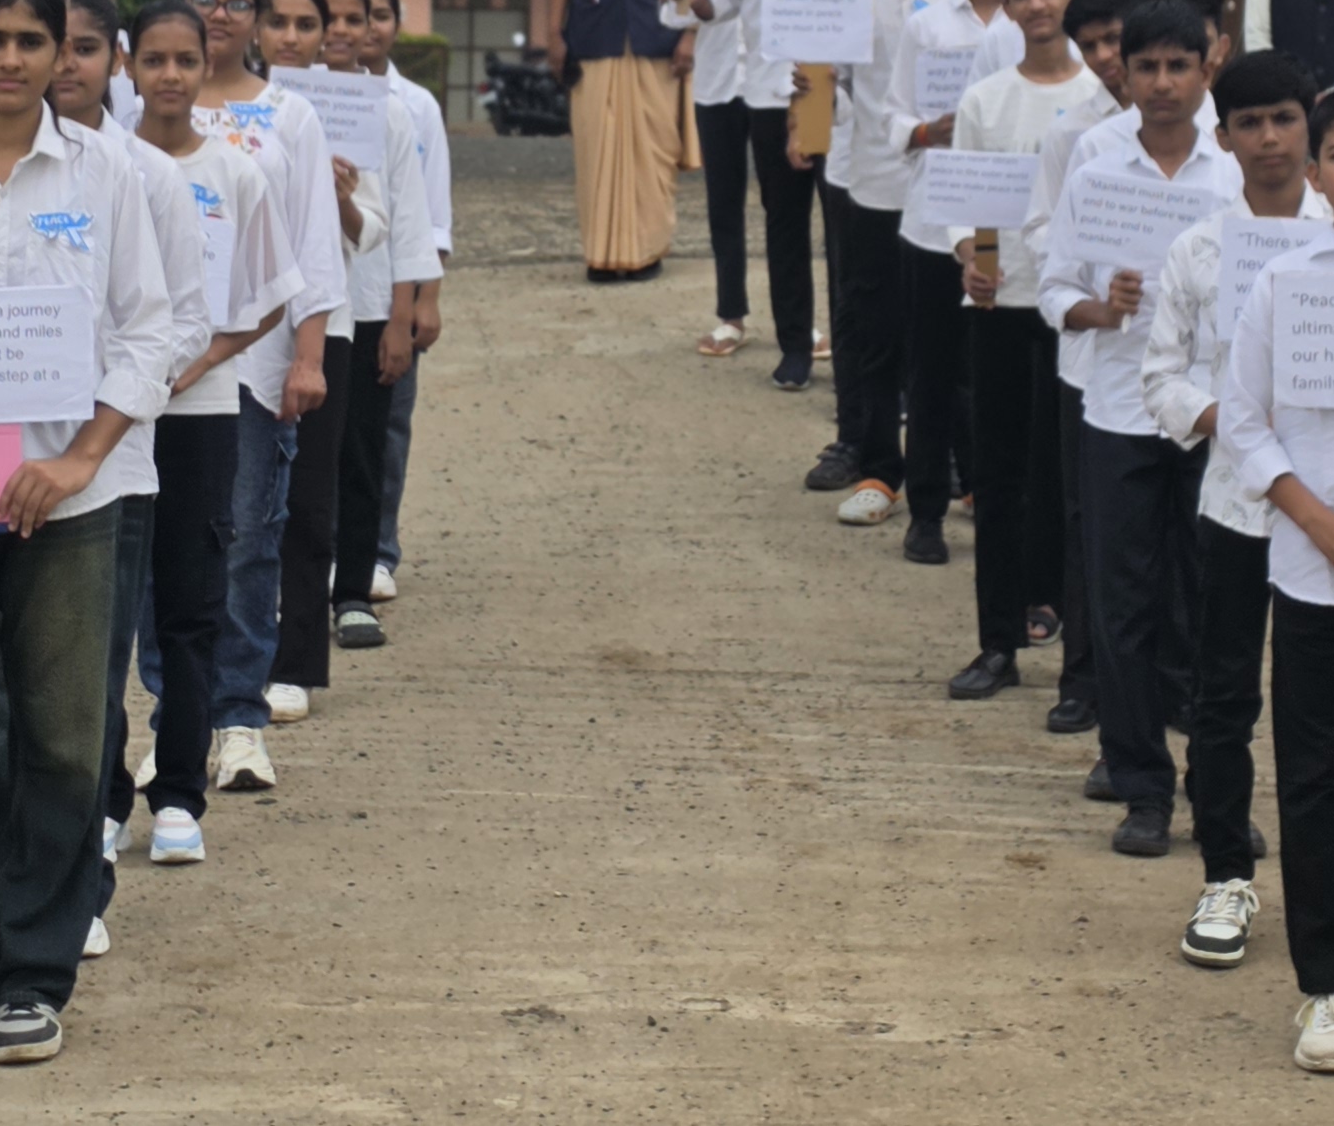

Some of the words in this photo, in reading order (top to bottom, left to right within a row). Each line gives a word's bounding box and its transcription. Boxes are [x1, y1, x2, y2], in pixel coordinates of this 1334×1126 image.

[1087, 177, 1136, 195] "Mankind
[1139, 188, 1165, 200] must
[1167, 193, 1185, 205] put
[1187, 196, 1201, 206] an
[1083, 197, 1103, 208] end
[1105, 200, 1117, 210] to
[1119, 204, 1138, 214] war
[1141, 205, 1175, 220] before
[1080, 214, 1103, 225] puts
[1105, 218, 1118, 227] an
[1121, 221, 1141, 232] end
[1143, 224, 1155, 235] to
[1238, 232, 1290, 248] "There
[1237, 259, 1266, 271] nev
[7, 304, 61, 321] journey
[25, 324, 63, 338] miles
[6, 347, 25, 361] be
[1292, 350, 1319, 363] our
[0, 370, 29, 385] step
[33, 368, 47, 382] at
[51, 369, 61, 380] a
